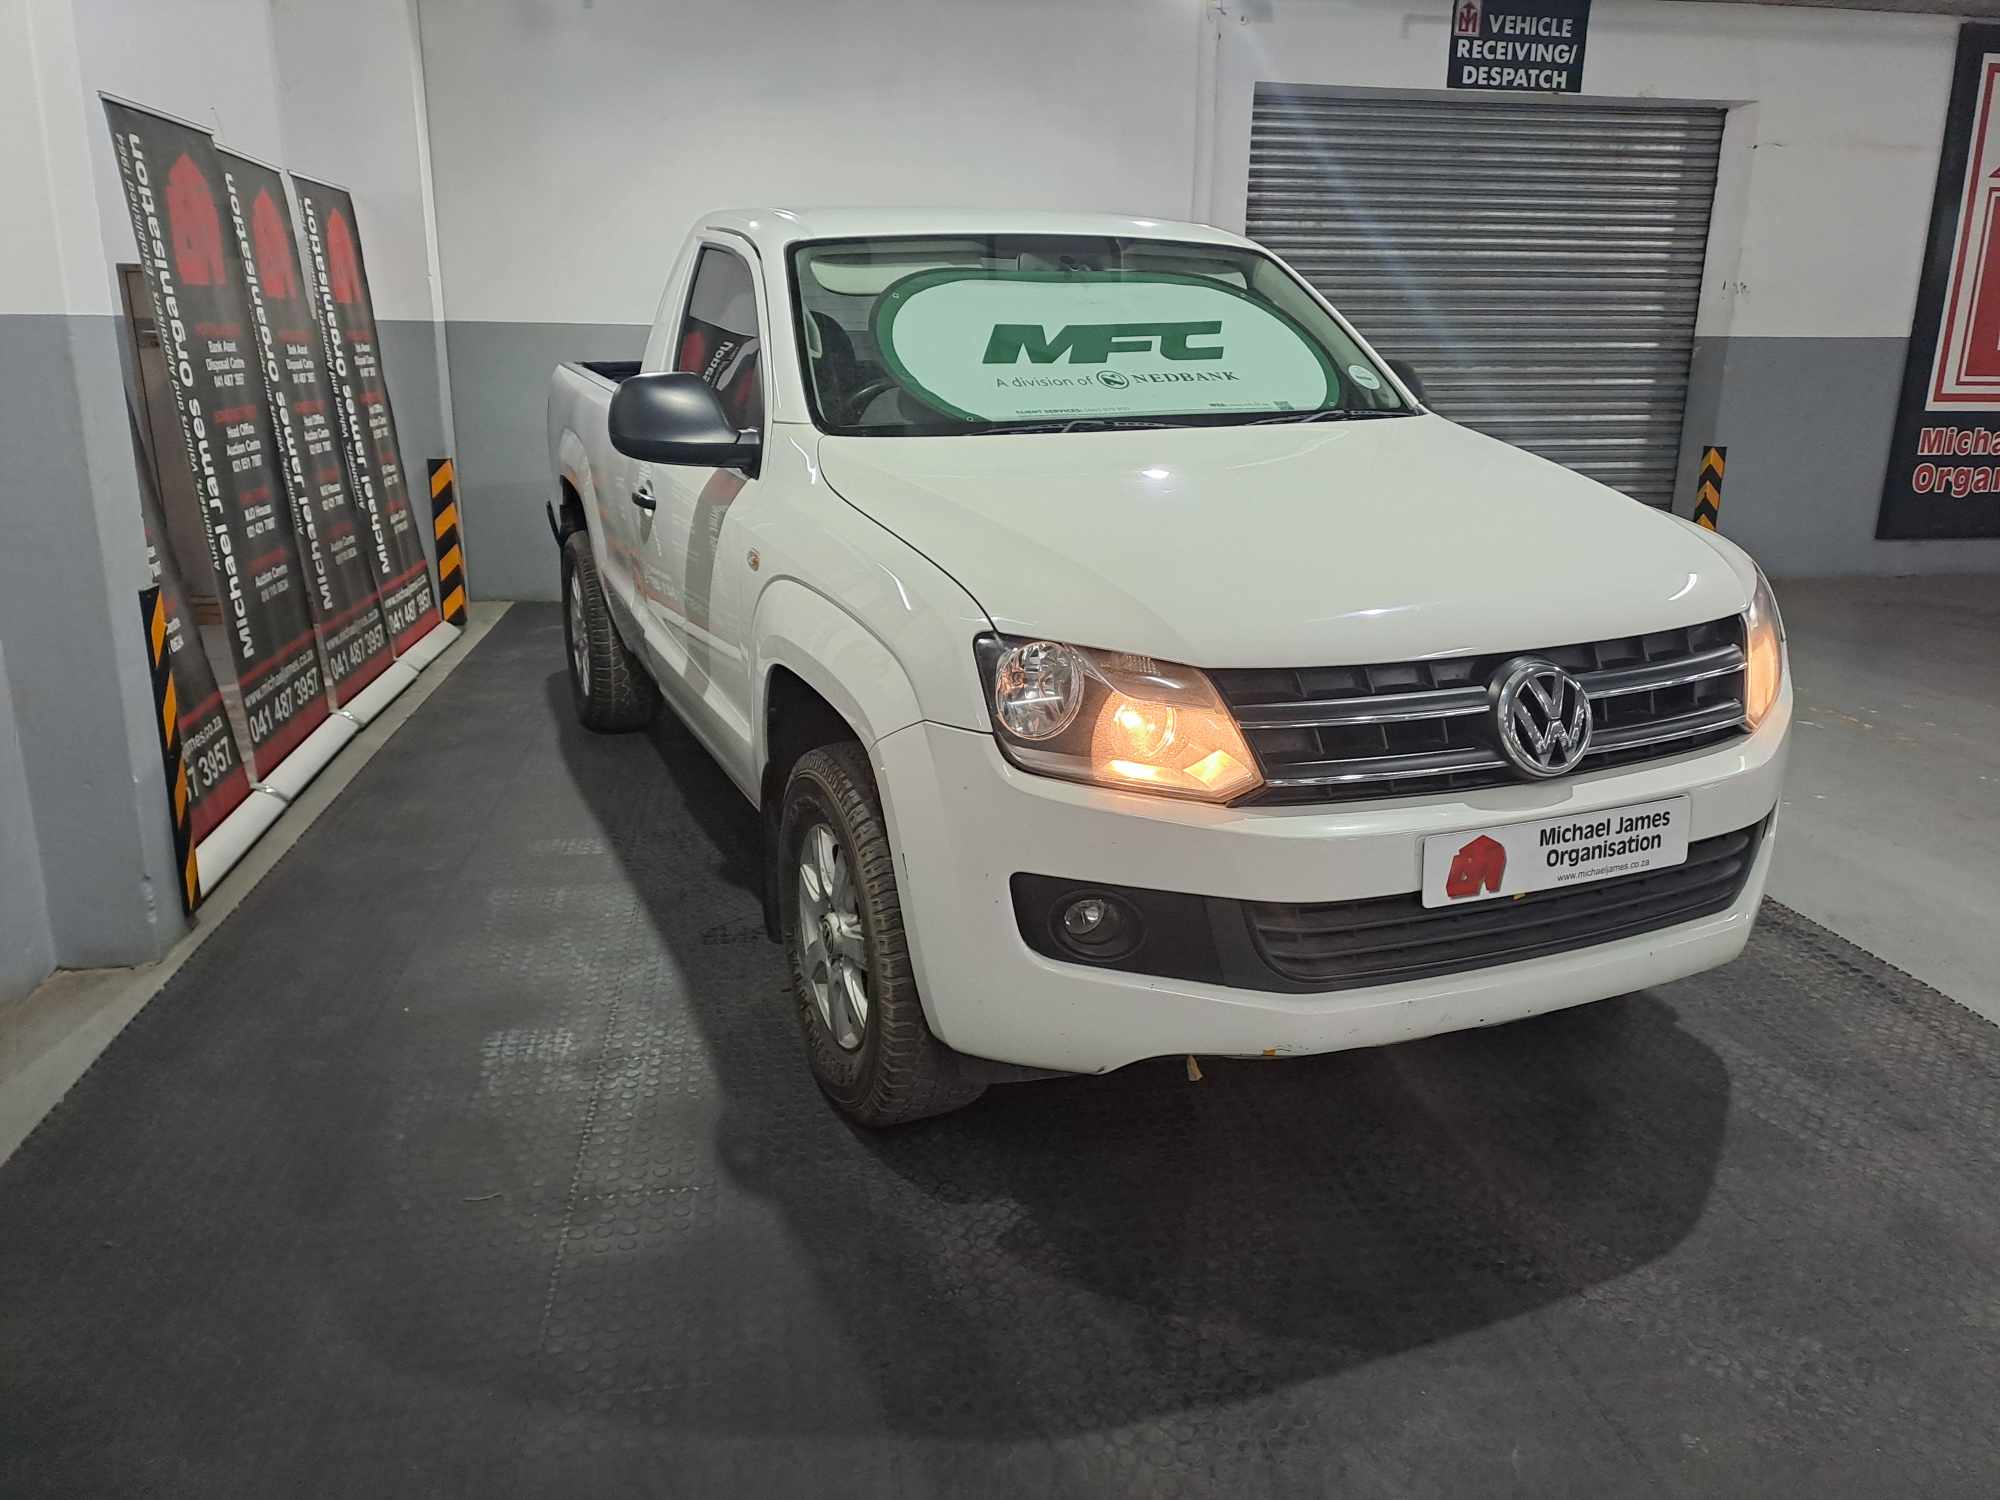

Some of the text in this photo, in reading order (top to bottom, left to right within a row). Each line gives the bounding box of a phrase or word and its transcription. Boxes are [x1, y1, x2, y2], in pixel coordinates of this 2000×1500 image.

[1456, 39, 1578, 64] RECEIVING/
[1489, 14, 1573, 37] VEHICLE
[1462, 65, 1567, 89] DESPATCH
[225, 172, 279, 382] Organisation
[303, 197, 347, 378] Organisation
[982, 320, 1223, 364] MFC
[128, 133, 255, 660] Michael James Organisation
[996, 370, 1240, 388] A division of NEDBANK
[275, 391, 305, 488] James
[342, 384, 367, 469] James
[360, 475, 391, 574] Michael
[298, 496, 333, 610] Michael
[330, 623, 385, 680] 041 487 3957
[249, 667, 319, 743] 041 487 3957
[198, 736, 232, 786] 3957
[1540, 811, 1671, 847] Michael James
[1546, 833, 1661, 867] Organisation
[1557, 859, 1650, 881] www.michaeljames.co.za
